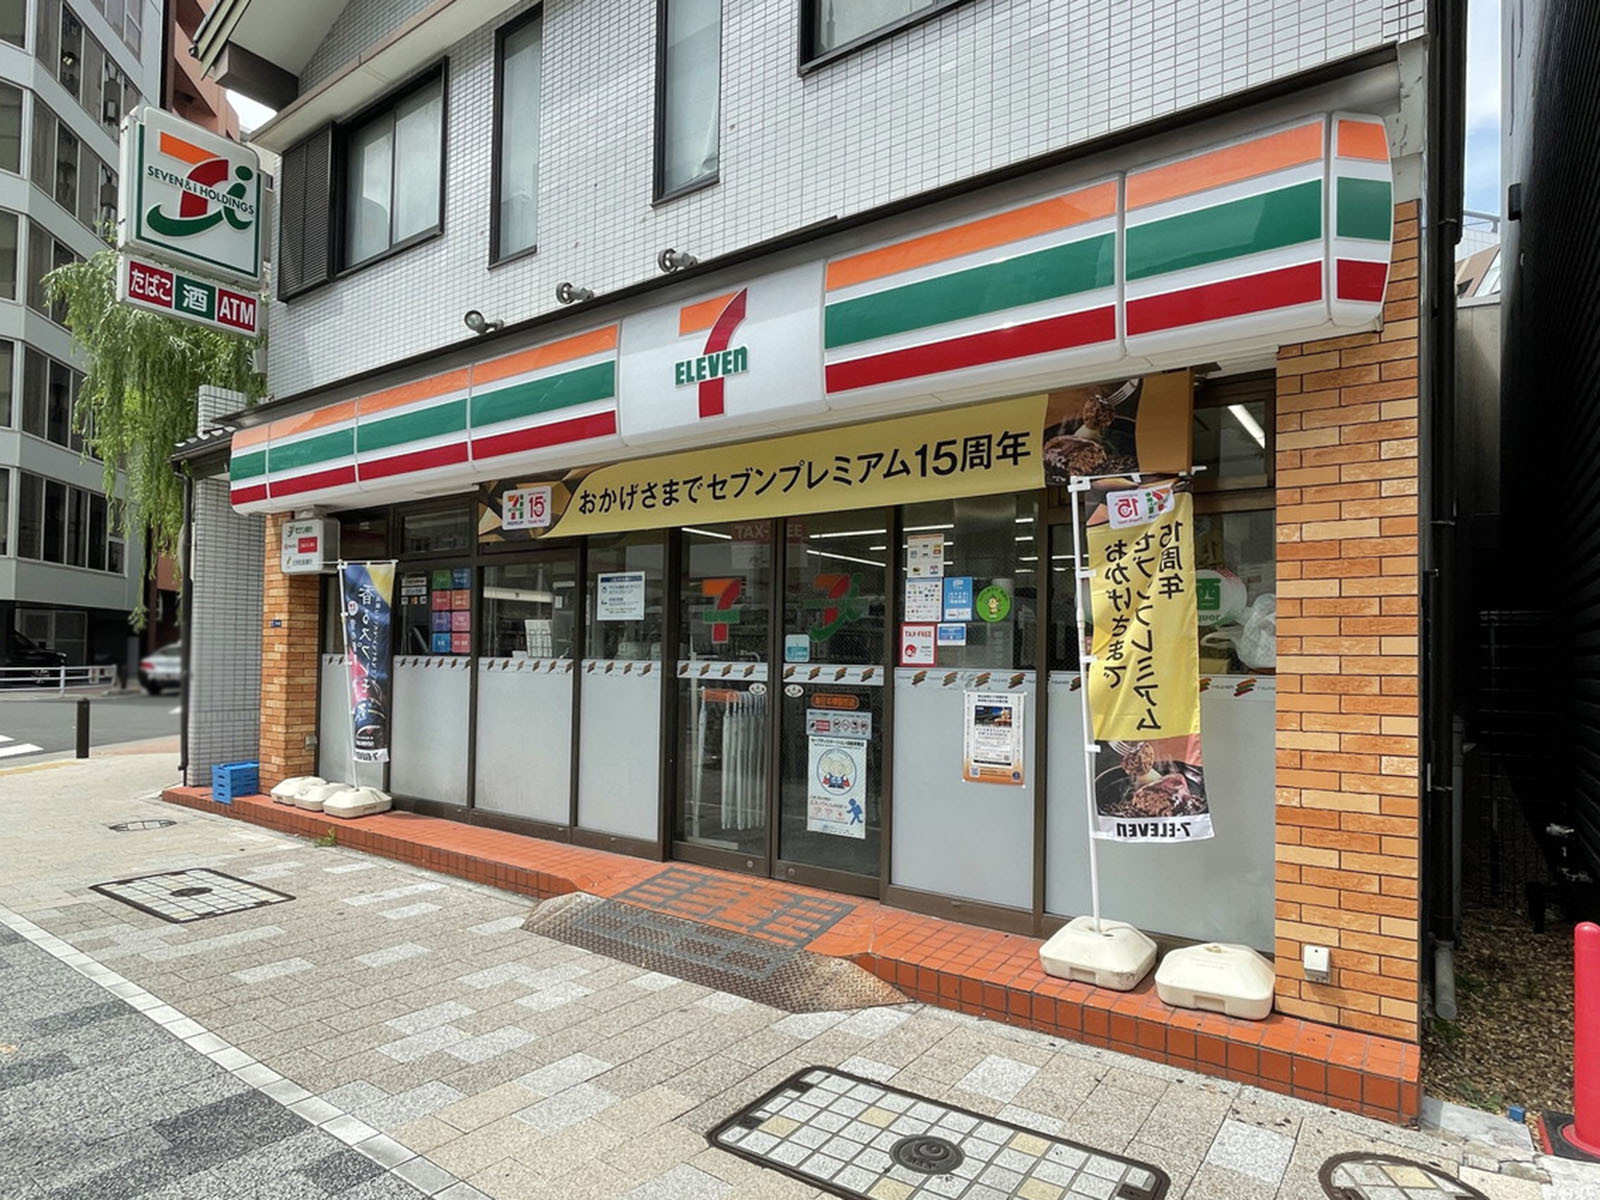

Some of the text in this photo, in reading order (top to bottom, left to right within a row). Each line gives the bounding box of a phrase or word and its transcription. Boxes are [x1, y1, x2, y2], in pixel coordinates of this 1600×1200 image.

[200, 186, 254, 215] HOLDINGS
[131, 268, 171, 301] たばこ
[182, 283, 209, 312] 酒
[219, 296, 254, 326] ATM
